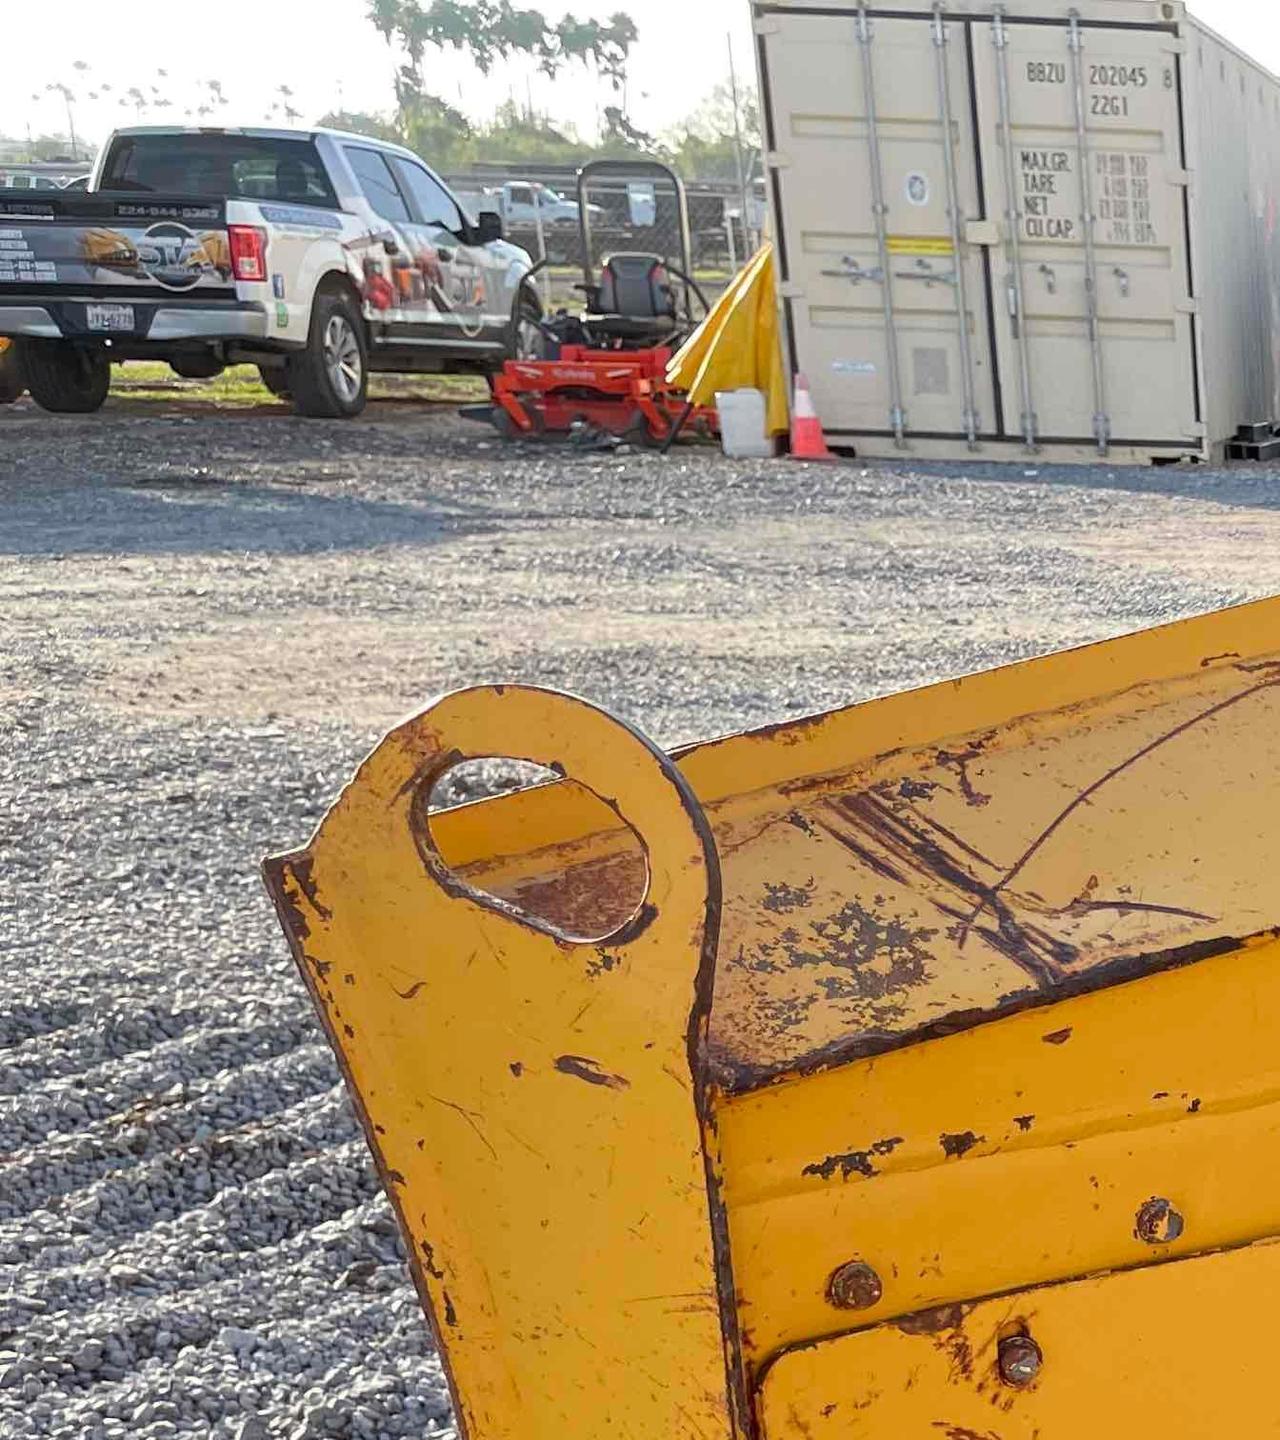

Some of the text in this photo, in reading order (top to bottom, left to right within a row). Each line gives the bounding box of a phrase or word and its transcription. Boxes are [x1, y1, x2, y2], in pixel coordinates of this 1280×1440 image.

[1089, 65, 1148, 87] 202045
[1023, 173, 1056, 194] TARE
[1024, 196, 1048, 215] NET
